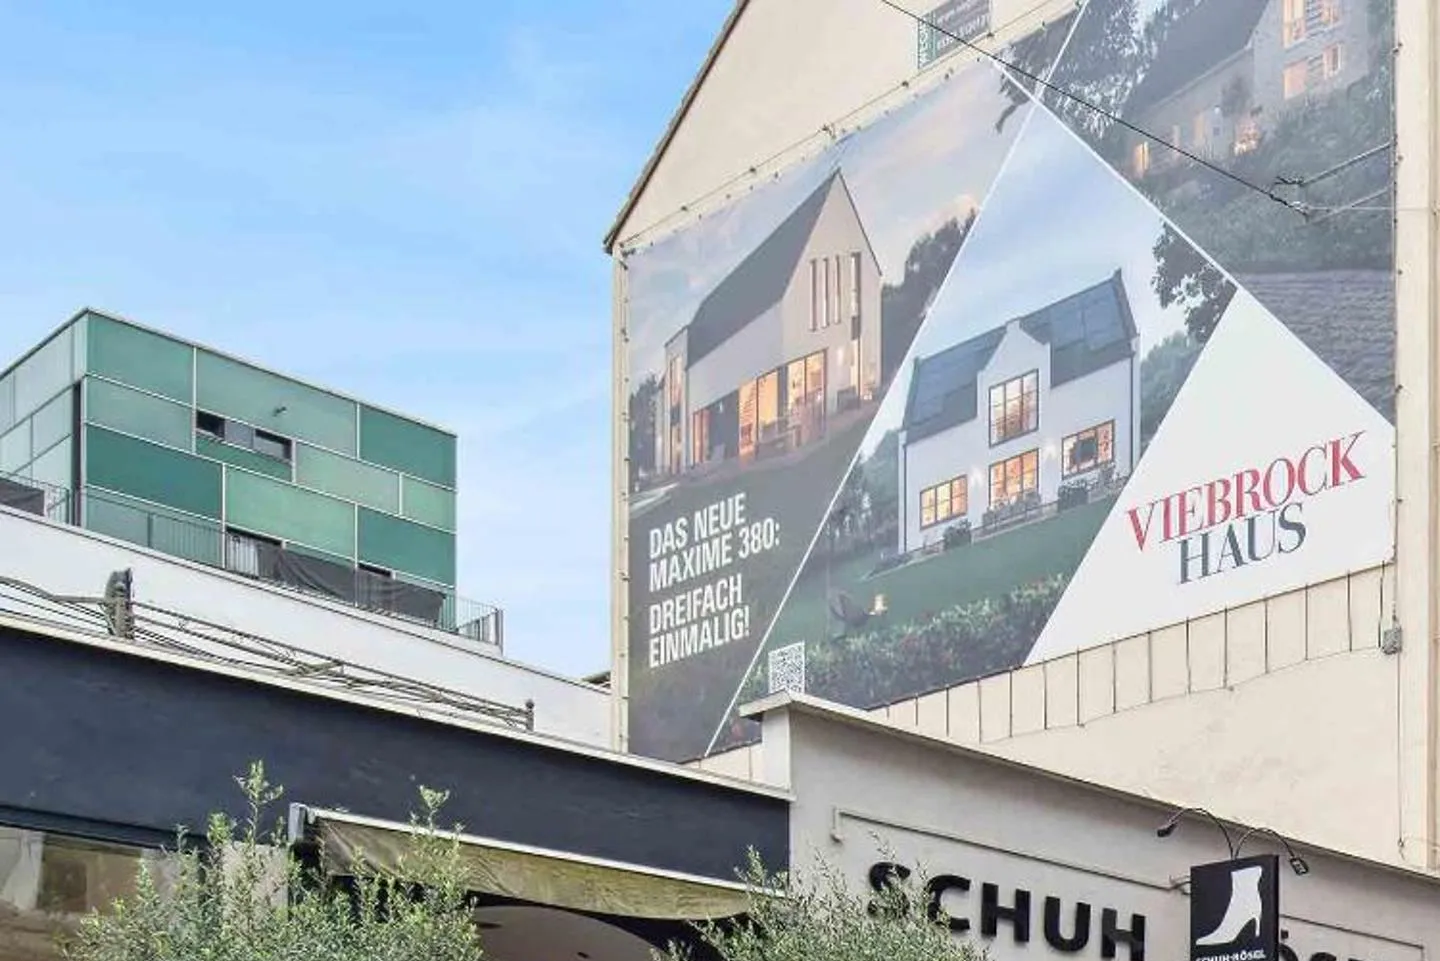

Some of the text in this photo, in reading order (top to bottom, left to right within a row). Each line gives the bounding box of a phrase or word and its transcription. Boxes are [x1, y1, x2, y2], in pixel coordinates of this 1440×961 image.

[649, 492, 746, 559] DAS NEUE
[1127, 430, 1367, 551] VIEBROCK
[649, 517, 780, 593] MAXIME 380:
[1177, 502, 1307, 584] HAUS
[649, 572, 743, 635] DREIFACH
[649, 605, 750, 669] EINMALIG!
